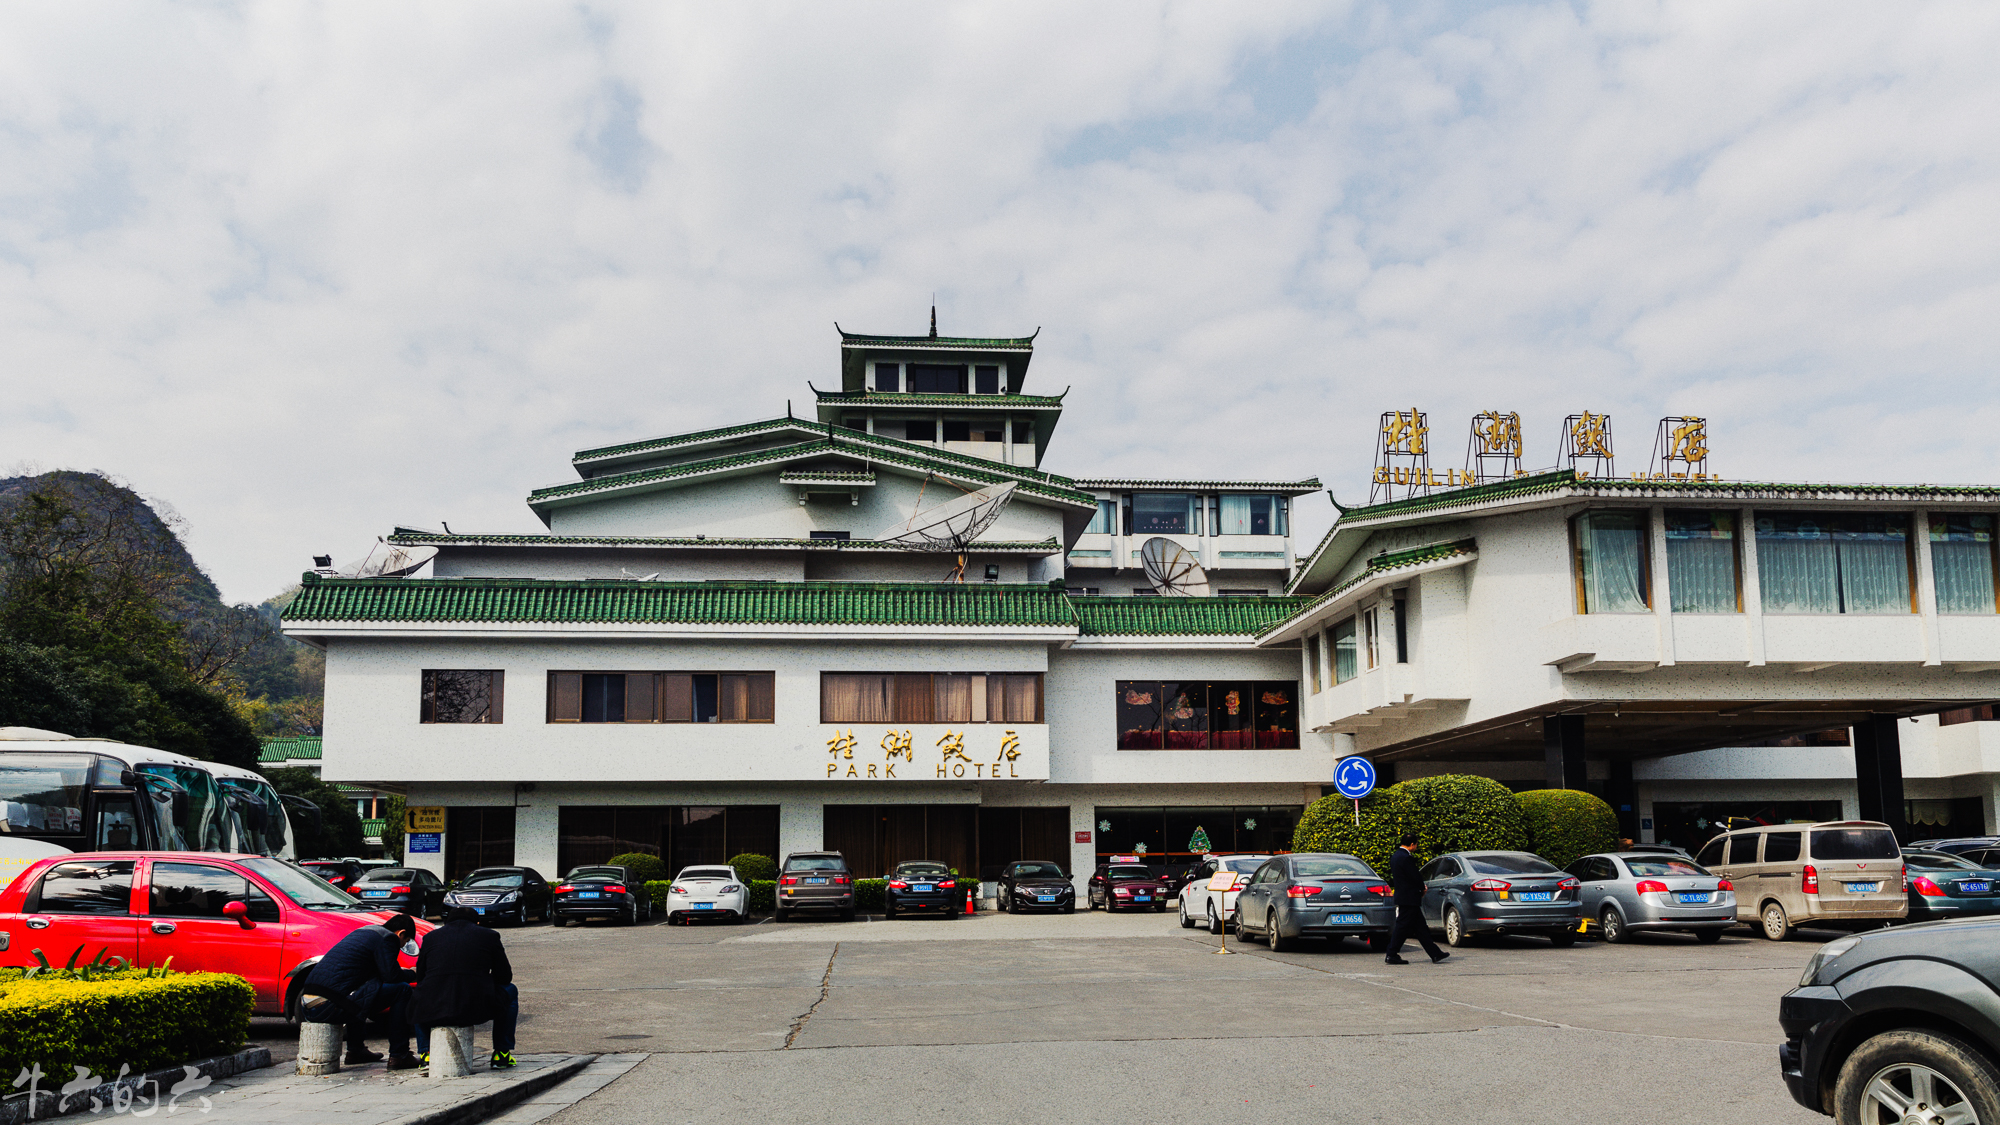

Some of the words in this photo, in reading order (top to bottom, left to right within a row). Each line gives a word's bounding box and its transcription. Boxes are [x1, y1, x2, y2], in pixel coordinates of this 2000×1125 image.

[1374, 466, 1475, 487] GUILIN
[827, 763, 897, 778] PARK
[936, 763, 1019, 778] HOTEL
